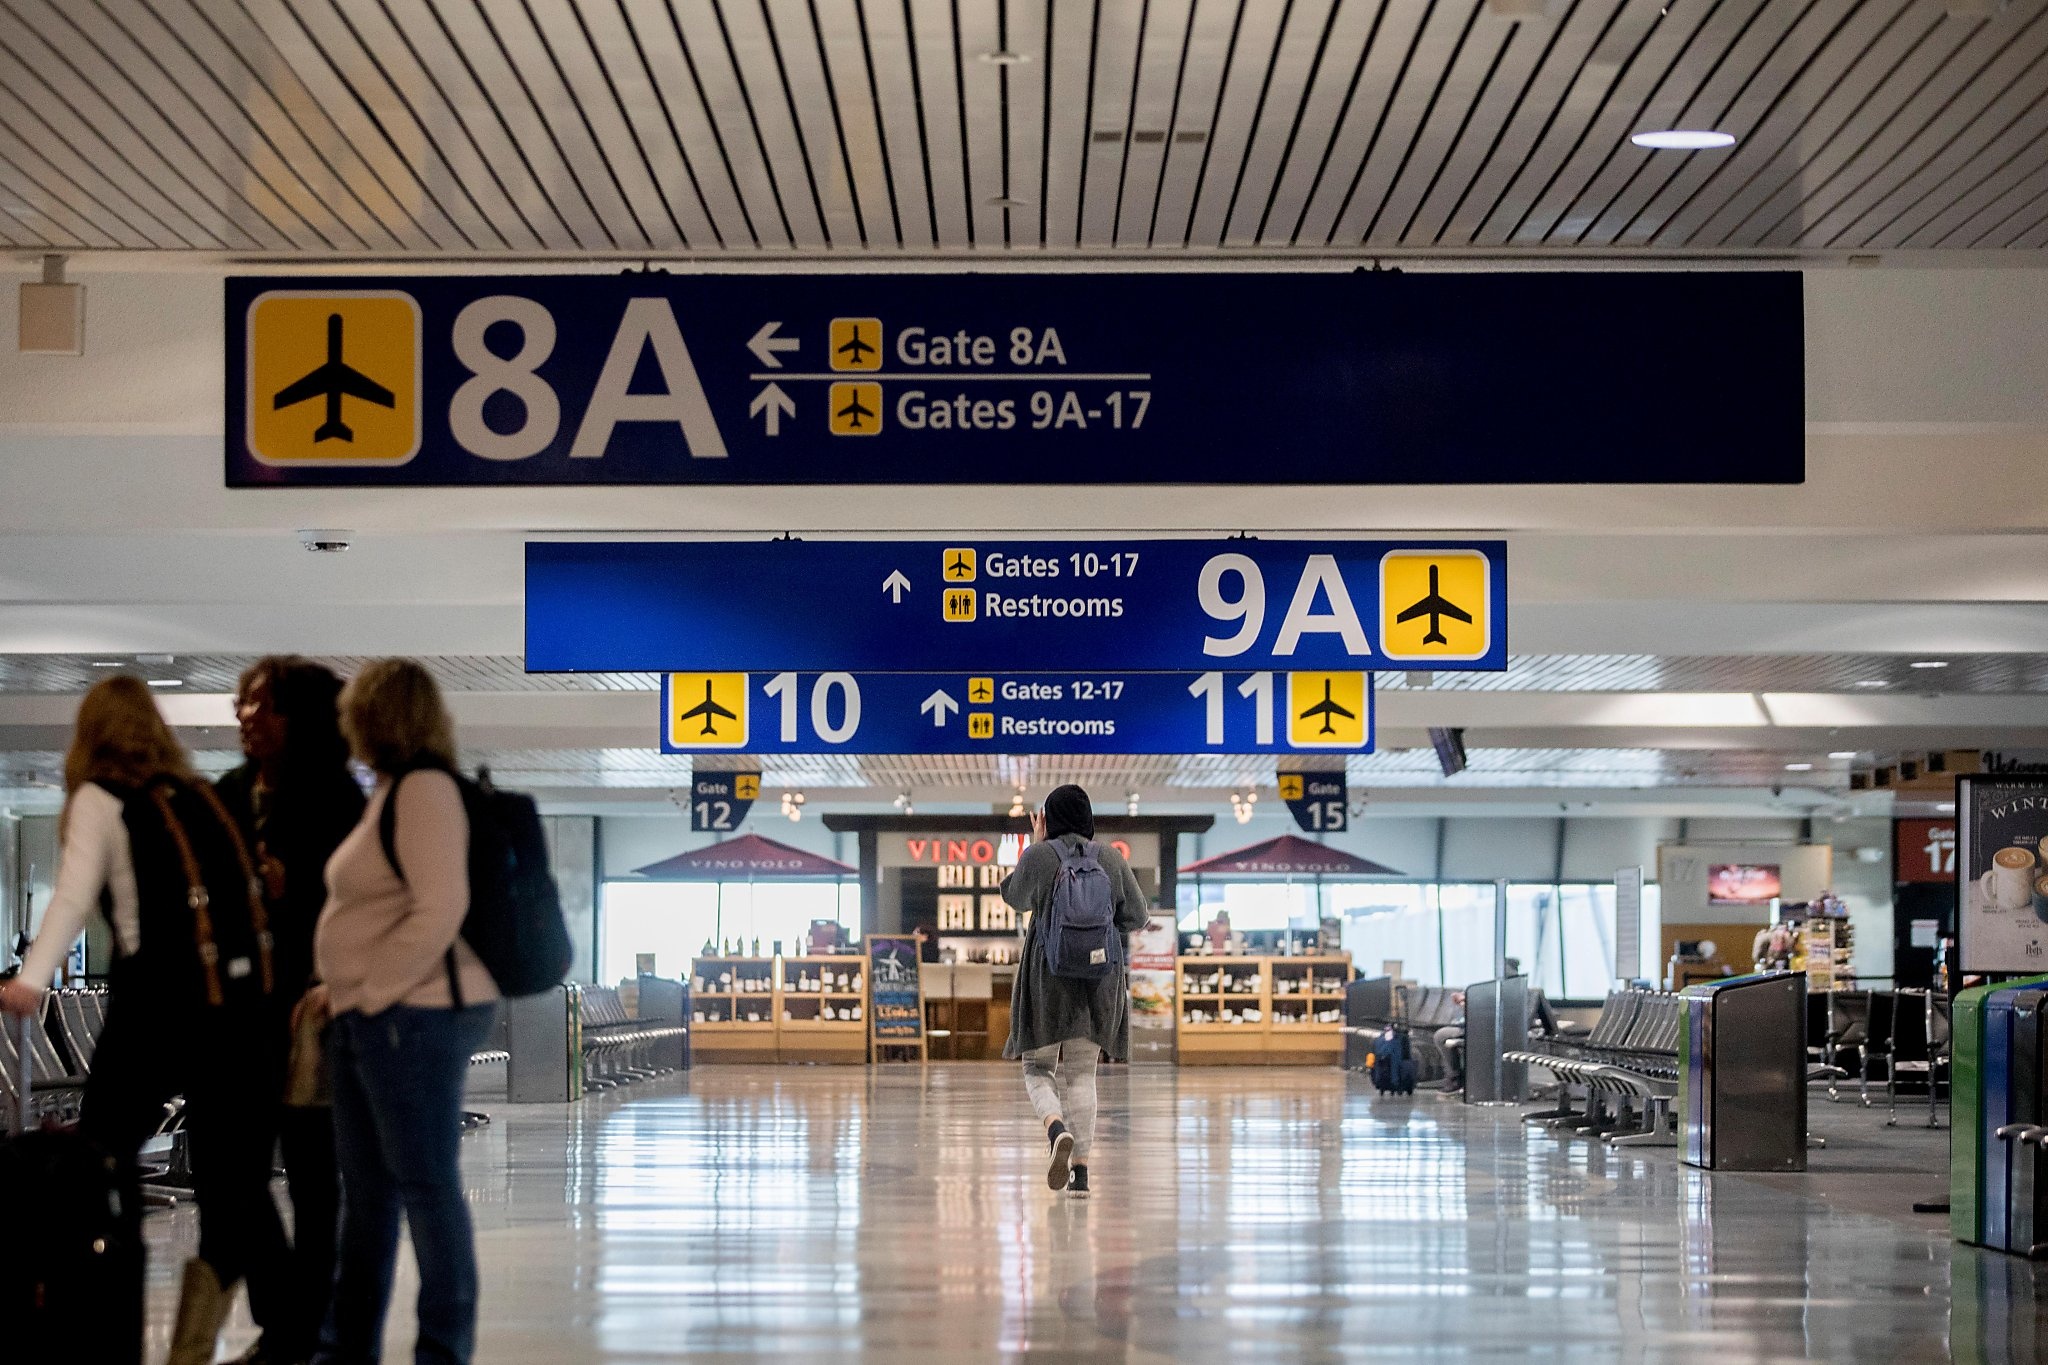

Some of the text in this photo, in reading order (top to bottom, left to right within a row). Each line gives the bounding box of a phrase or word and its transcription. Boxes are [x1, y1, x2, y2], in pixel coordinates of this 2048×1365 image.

[897, 327, 1067, 365] Gate 8A
[449, 295, 728, 462] 8A
[897, 391, 1151, 429] Gates 9A-17
[986, 553, 1139, 577] Gates 10-17
[986, 593, 1124, 617] Restrooms
[1198, 552, 1372, 657] 9A
[1002, 681, 1124, 700] Gates 12-17
[763, 673, 861, 743] 10
[1188, 673, 1274, 745] 11
[1002, 717, 1115, 735] Restrooms
[697, 782, 728, 794] Gate
[1308, 782, 1340, 795] Gate
[696, 801, 731, 829] 12
[1307, 802, 1344, 829] 15
[907, 839, 994, 863] VINO
[691, 860, 803, 869] VINO VOLO
[1236, 862, 1291, 872] VINO
